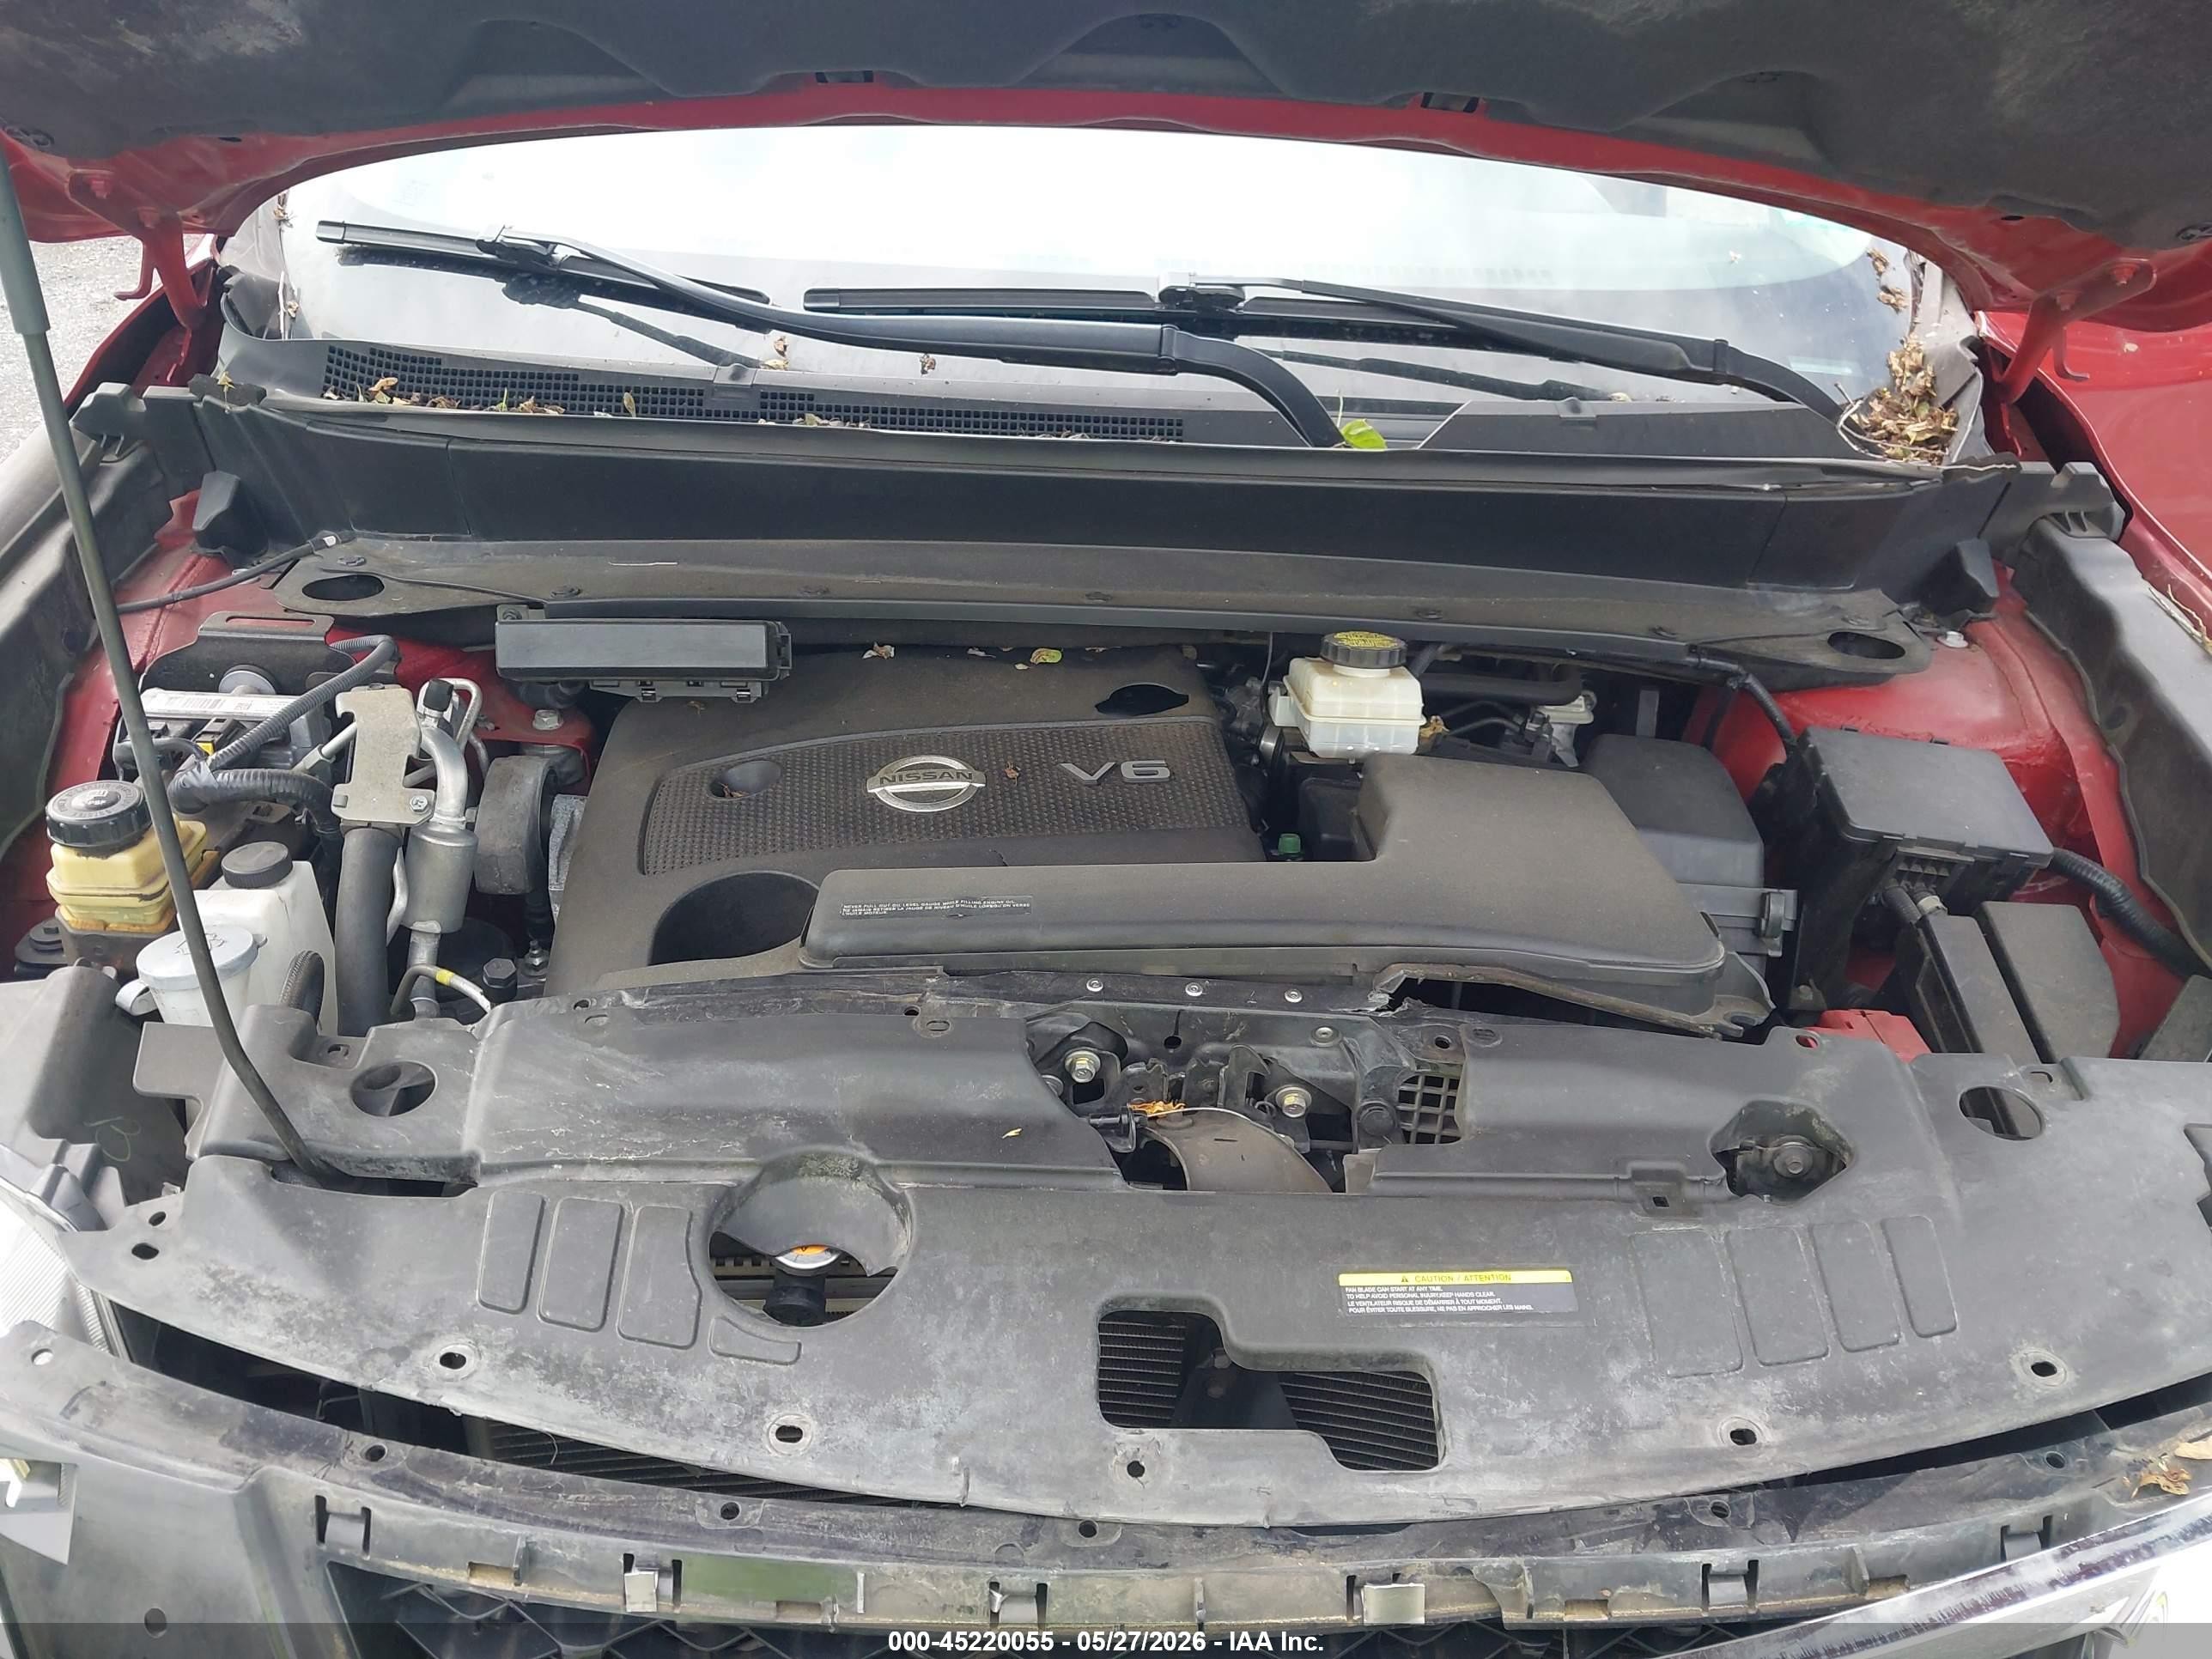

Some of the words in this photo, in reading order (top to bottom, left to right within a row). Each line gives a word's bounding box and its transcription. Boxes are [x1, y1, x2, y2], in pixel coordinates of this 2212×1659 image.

[879, 771, 973, 785] NISSAN
[1059, 760, 1170, 785] V6
[1464, 1273, 1511, 1282] ATTENTION
